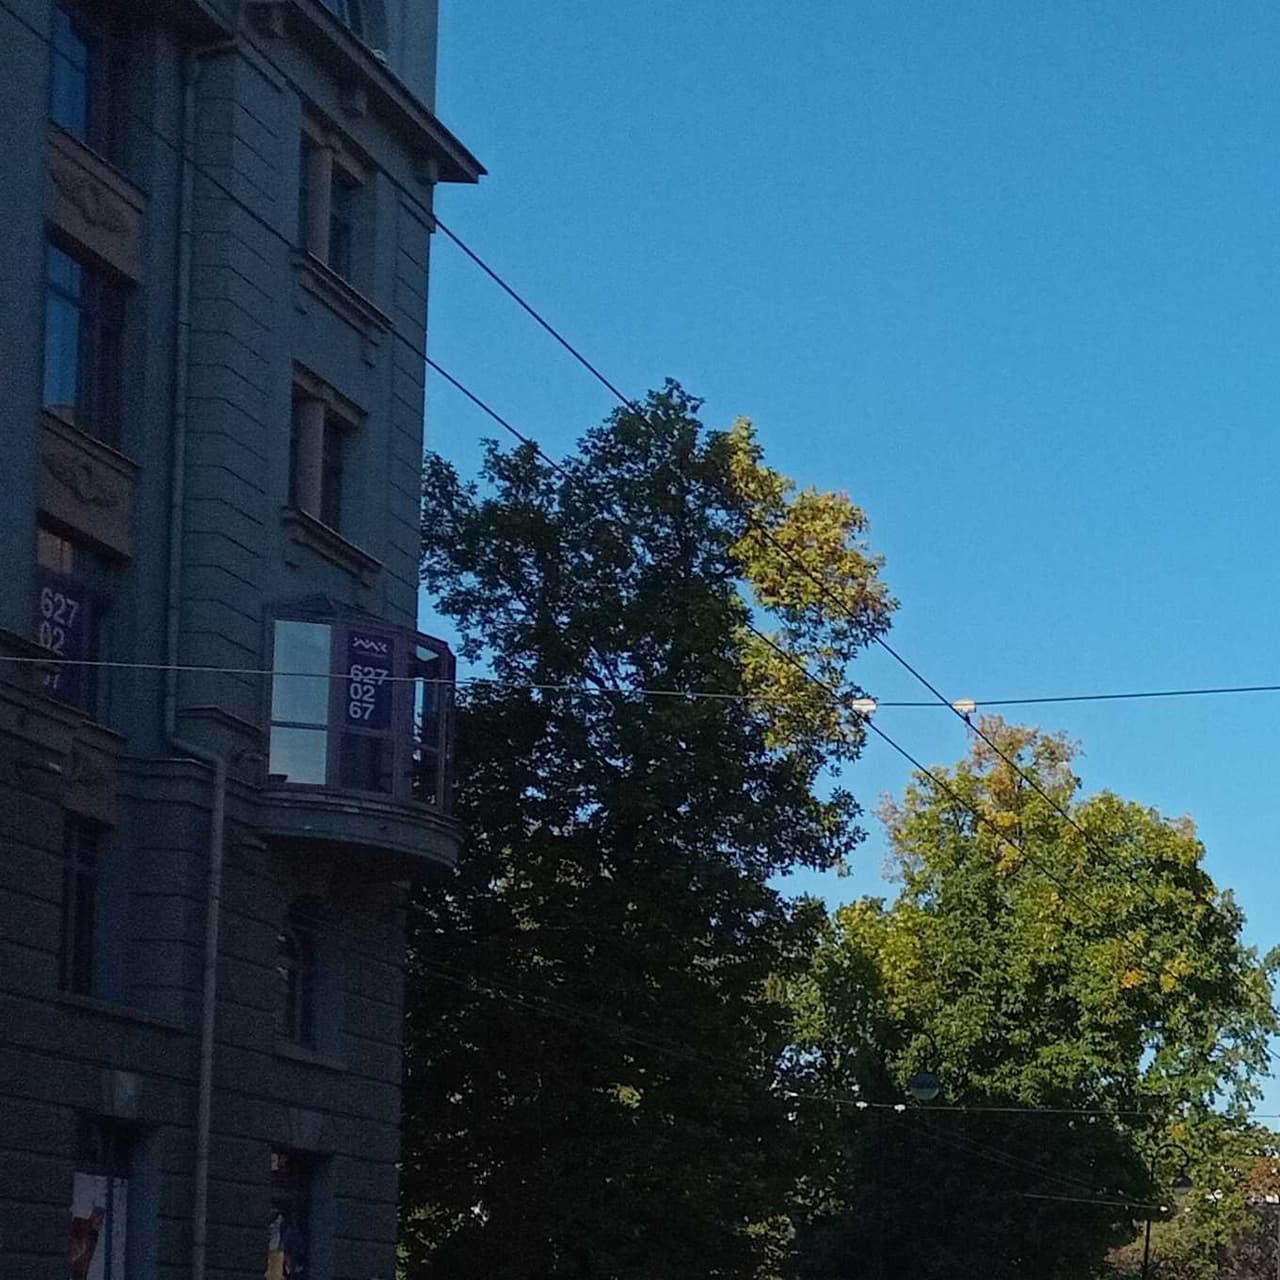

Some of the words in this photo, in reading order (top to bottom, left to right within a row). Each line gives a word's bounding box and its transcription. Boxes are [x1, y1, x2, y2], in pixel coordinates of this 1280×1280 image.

[42, 588, 79, 627] 627
[351, 664, 388, 685] 627
[350, 683, 375, 701] 02
[349, 702, 374, 719] 67
